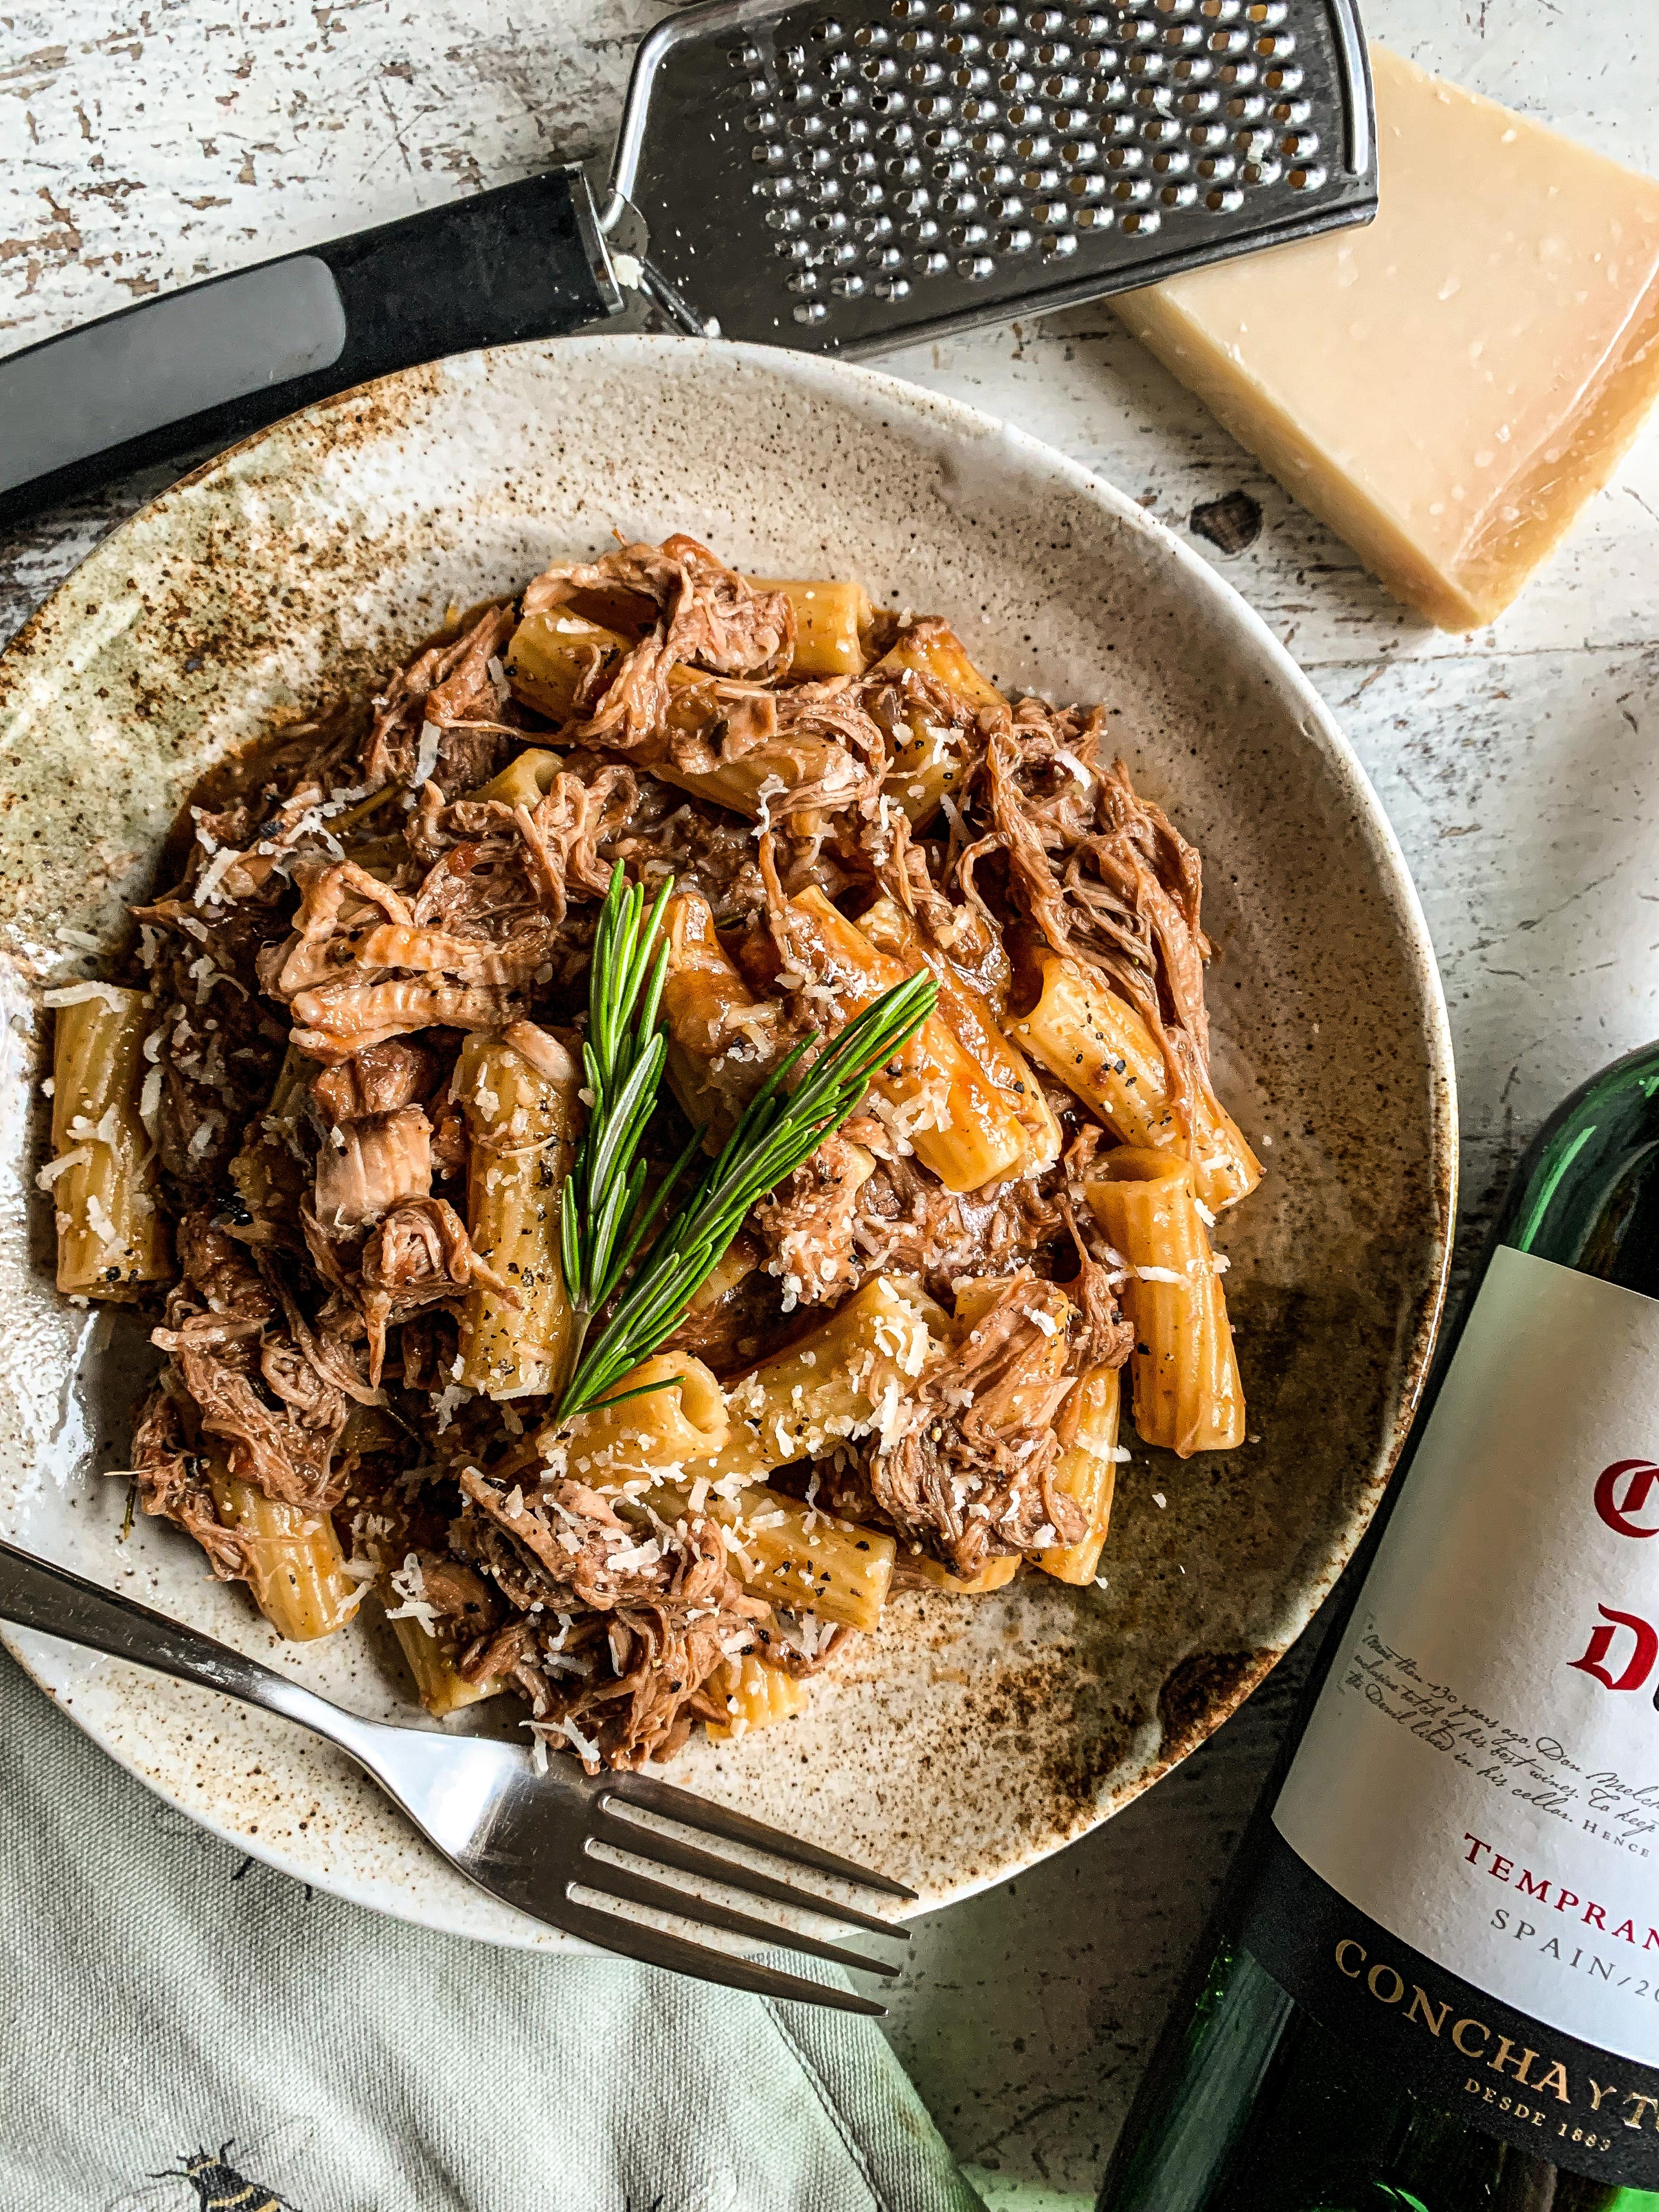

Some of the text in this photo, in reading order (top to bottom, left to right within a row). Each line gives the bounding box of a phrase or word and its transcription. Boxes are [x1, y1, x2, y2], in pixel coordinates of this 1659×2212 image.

[1427, 1683, 1458, 1703] 130
[1448, 1704, 1500, 1728] years
[1491, 1729, 1531, 1748] ago,
[1536, 1737, 1581, 1772] Don
[1455, 1752, 1474, 1767] in
[1476, 1766, 1508, 1787] his
[1512, 1789, 1573, 1822] cellar.
[1582, 1818, 1649, 1858] HENCE
[1459, 1728, 1488, 1748] his
[1490, 1745, 1545, 1772] best
[1530, 1770, 1579, 1798] wines.
[1588, 1788, 1621, 1812] To
[1614, 1808, 1656, 1837] keep
[1335, 1939, 1659, 2133] CONCHA Y T
[1464, 2078, 1611, 2152] DESDE 1883
